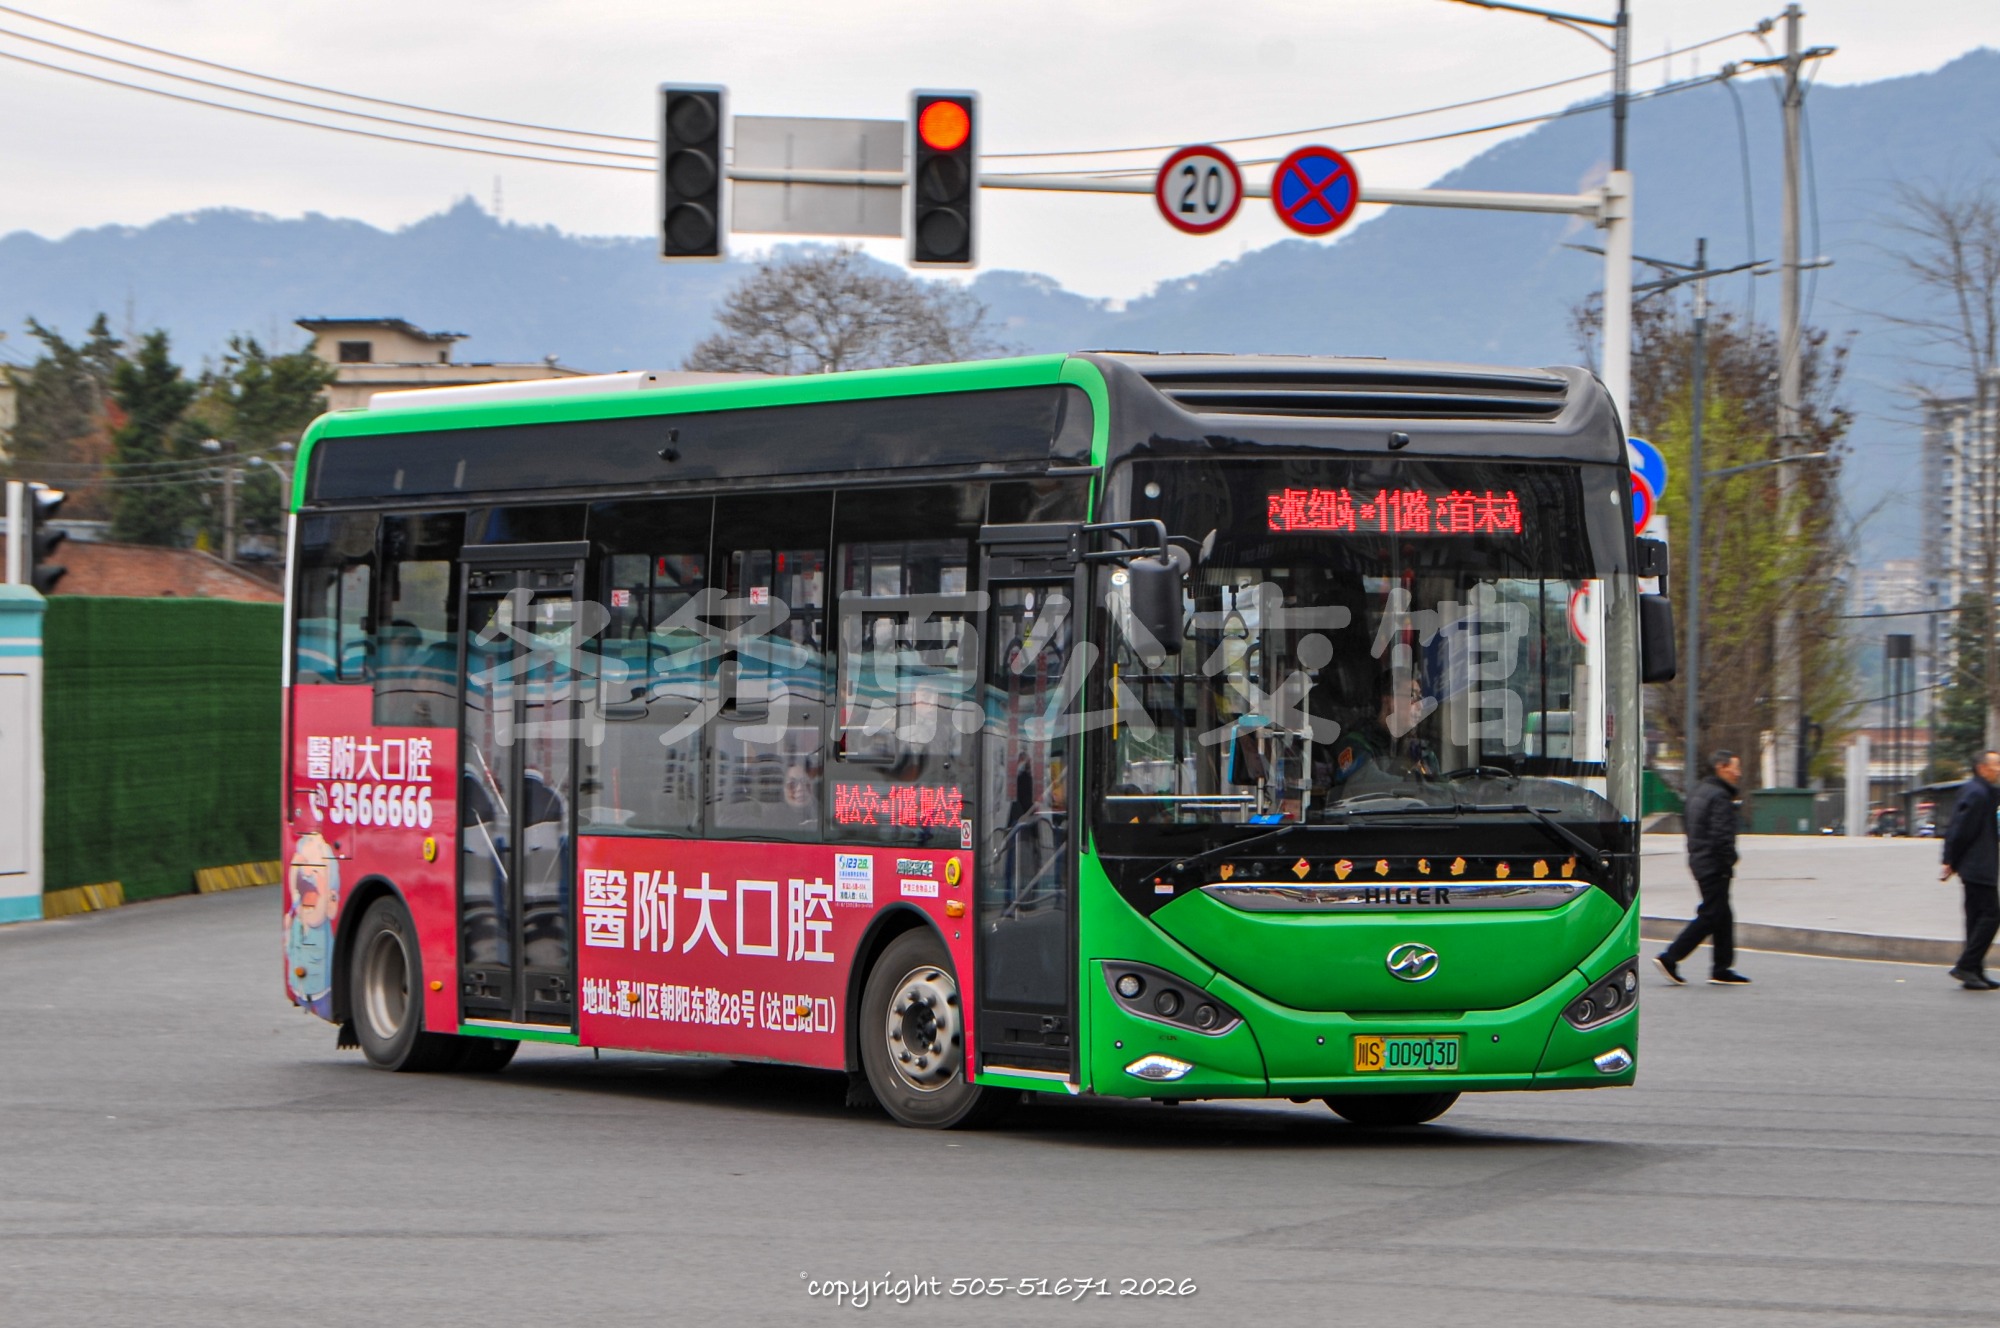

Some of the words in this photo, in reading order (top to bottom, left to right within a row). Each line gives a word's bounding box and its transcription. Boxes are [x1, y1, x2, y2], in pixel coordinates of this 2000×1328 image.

[1180, 165, 1223, 213] 20
[307, 735, 432, 782] 醫附大口腔
[329, 782, 433, 829] 3566666
[583, 868, 835, 963] 醫附大口腔
[1365, 887, 1450, 904] HIGER
[1389, 1042, 1457, 1066] 00903D
